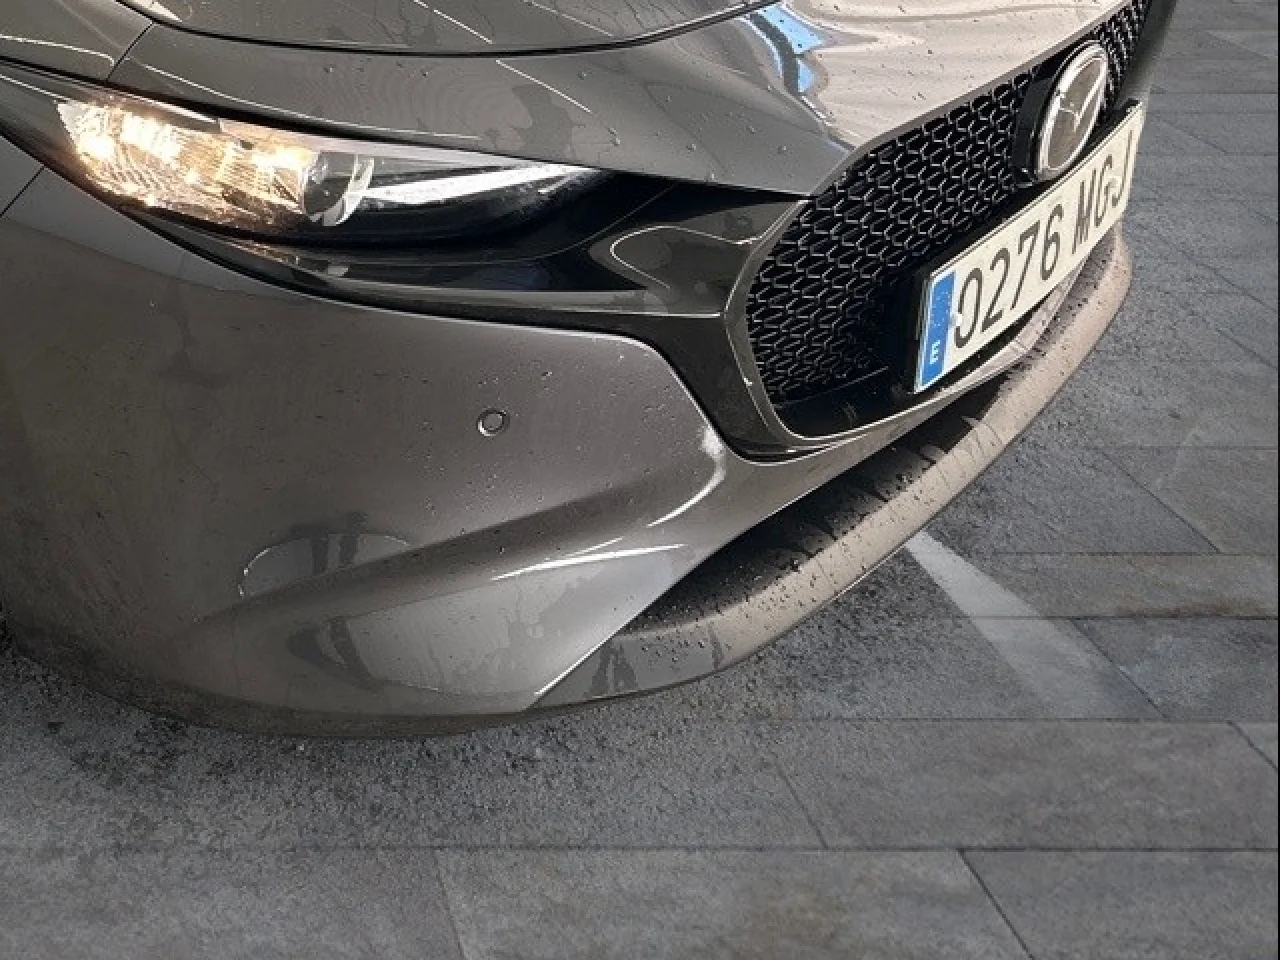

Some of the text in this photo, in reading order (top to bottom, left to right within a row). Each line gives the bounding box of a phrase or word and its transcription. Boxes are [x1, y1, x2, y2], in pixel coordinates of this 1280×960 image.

[954, 129, 1132, 349] 0276 MGJ
[929, 340, 941, 365] E
